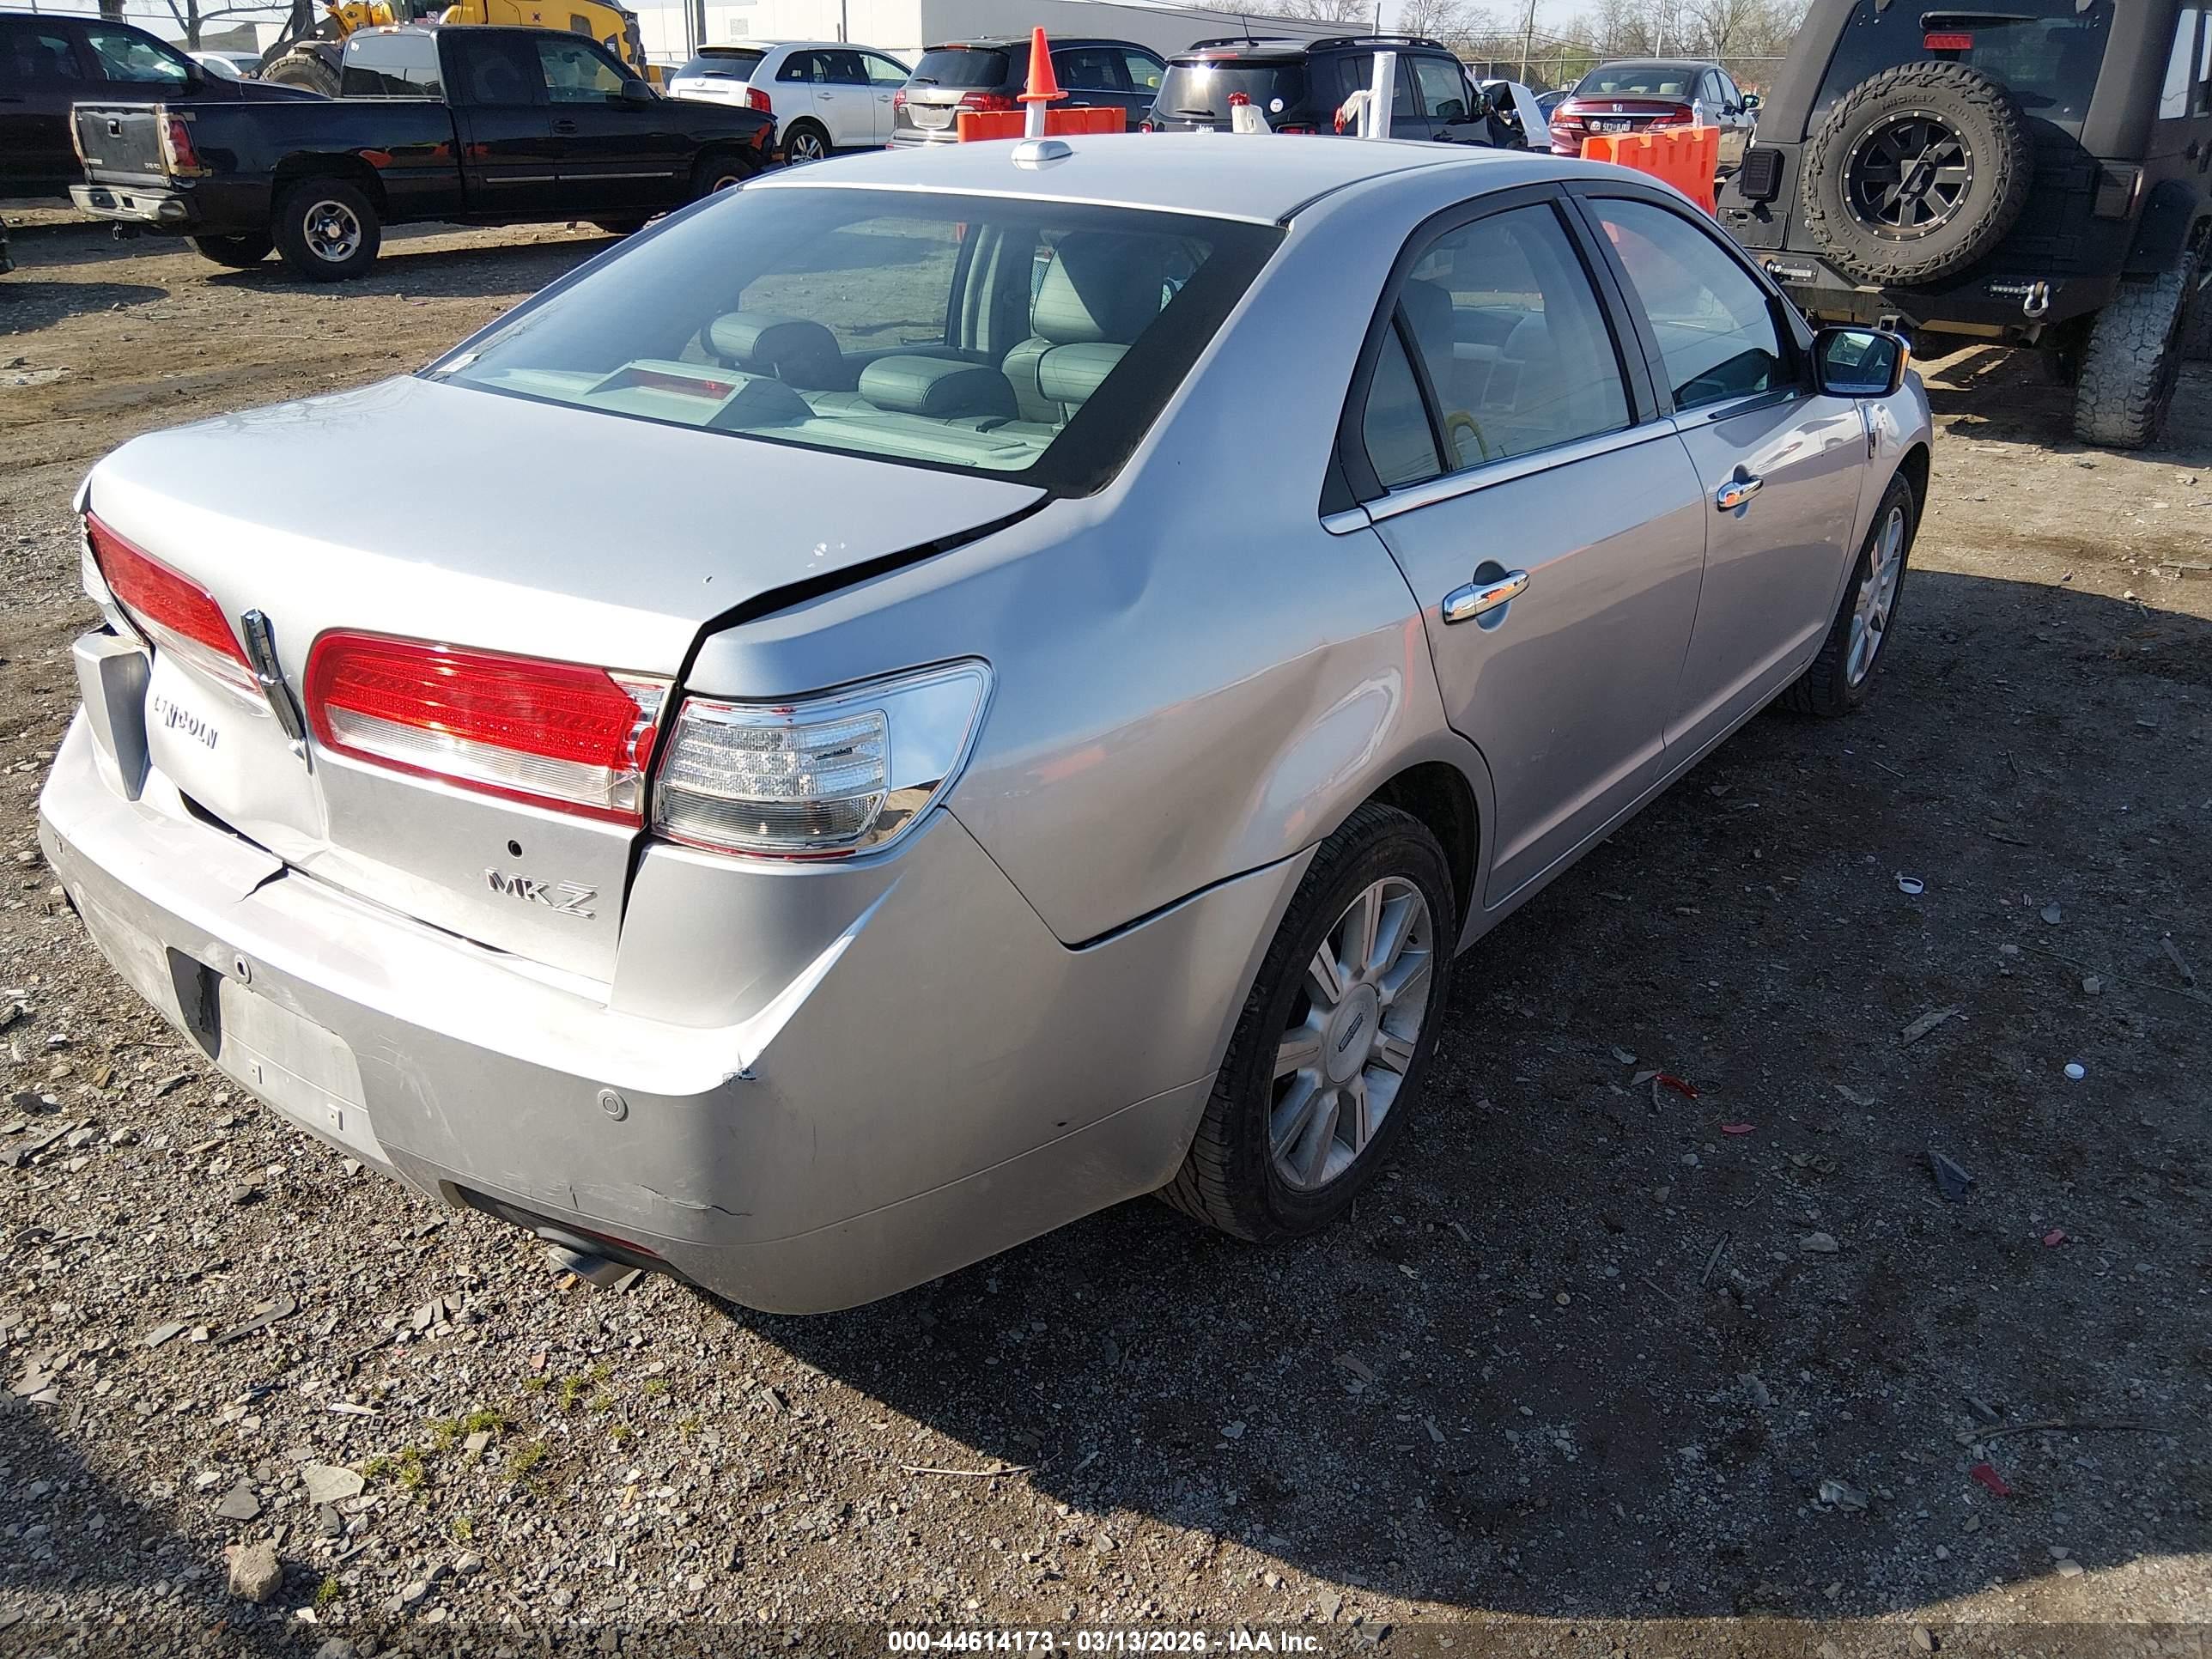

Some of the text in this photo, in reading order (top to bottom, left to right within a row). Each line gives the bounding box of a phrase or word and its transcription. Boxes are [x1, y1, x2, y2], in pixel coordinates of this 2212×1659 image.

[1881, 94, 1937, 111] MICKEY
[1195, 123, 1214, 136] Jeep
[155, 694, 218, 750] LINCOLN
[484, 866, 599, 921] MKZ
